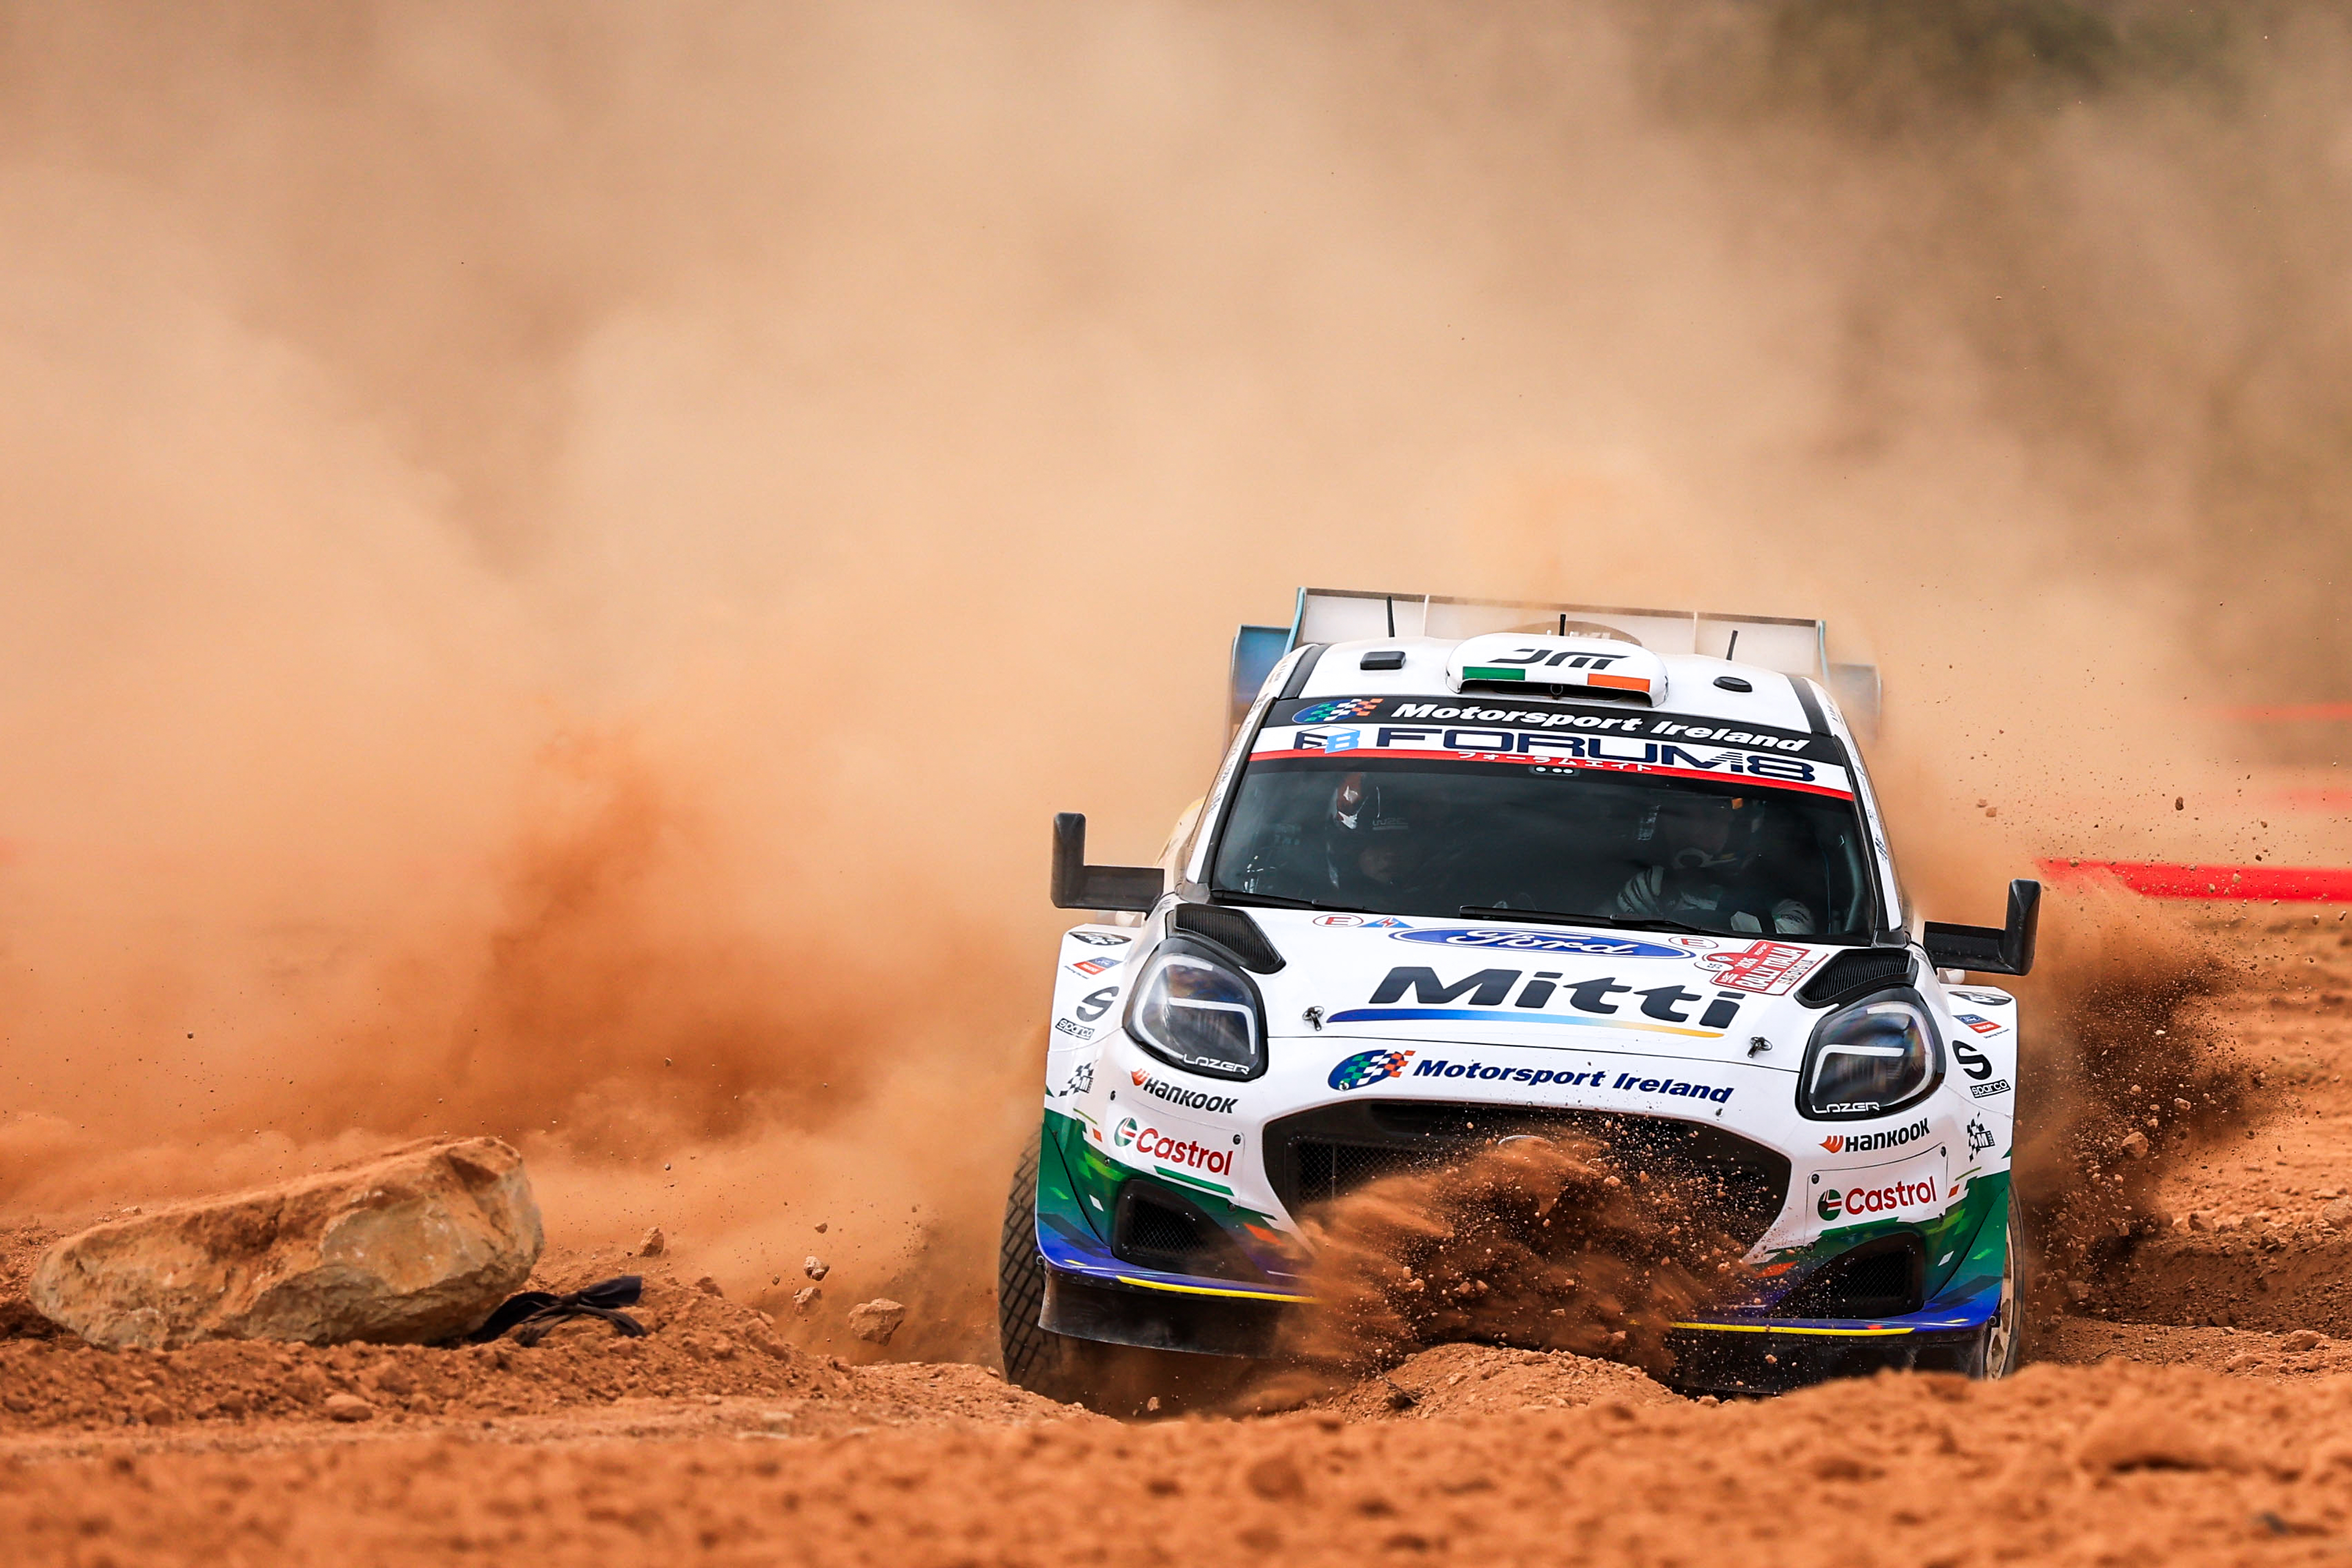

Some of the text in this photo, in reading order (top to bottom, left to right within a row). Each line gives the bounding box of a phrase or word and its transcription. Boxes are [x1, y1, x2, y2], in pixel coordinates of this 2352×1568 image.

[1391, 703, 1811, 752] Motorsport Ireland
[1376, 727, 1815, 782] FORUM8
[1457, 751, 1652, 772] フォーラムエイト
[1446, 930, 1639, 954] Ford
[1735, 966, 1782, 989] RALLY
[1761, 947, 1806, 969] ITALIA
[1368, 966, 1746, 1029] Mitti
[1058, 1019, 1093, 1037] sparco
[1413, 1059, 1734, 1104] Motorsport Ireland
[1971, 1081, 2008, 1097] sparco
[1136, 1128, 1233, 1175] Castrol
[1845, 1176, 1937, 1215] Castrol
